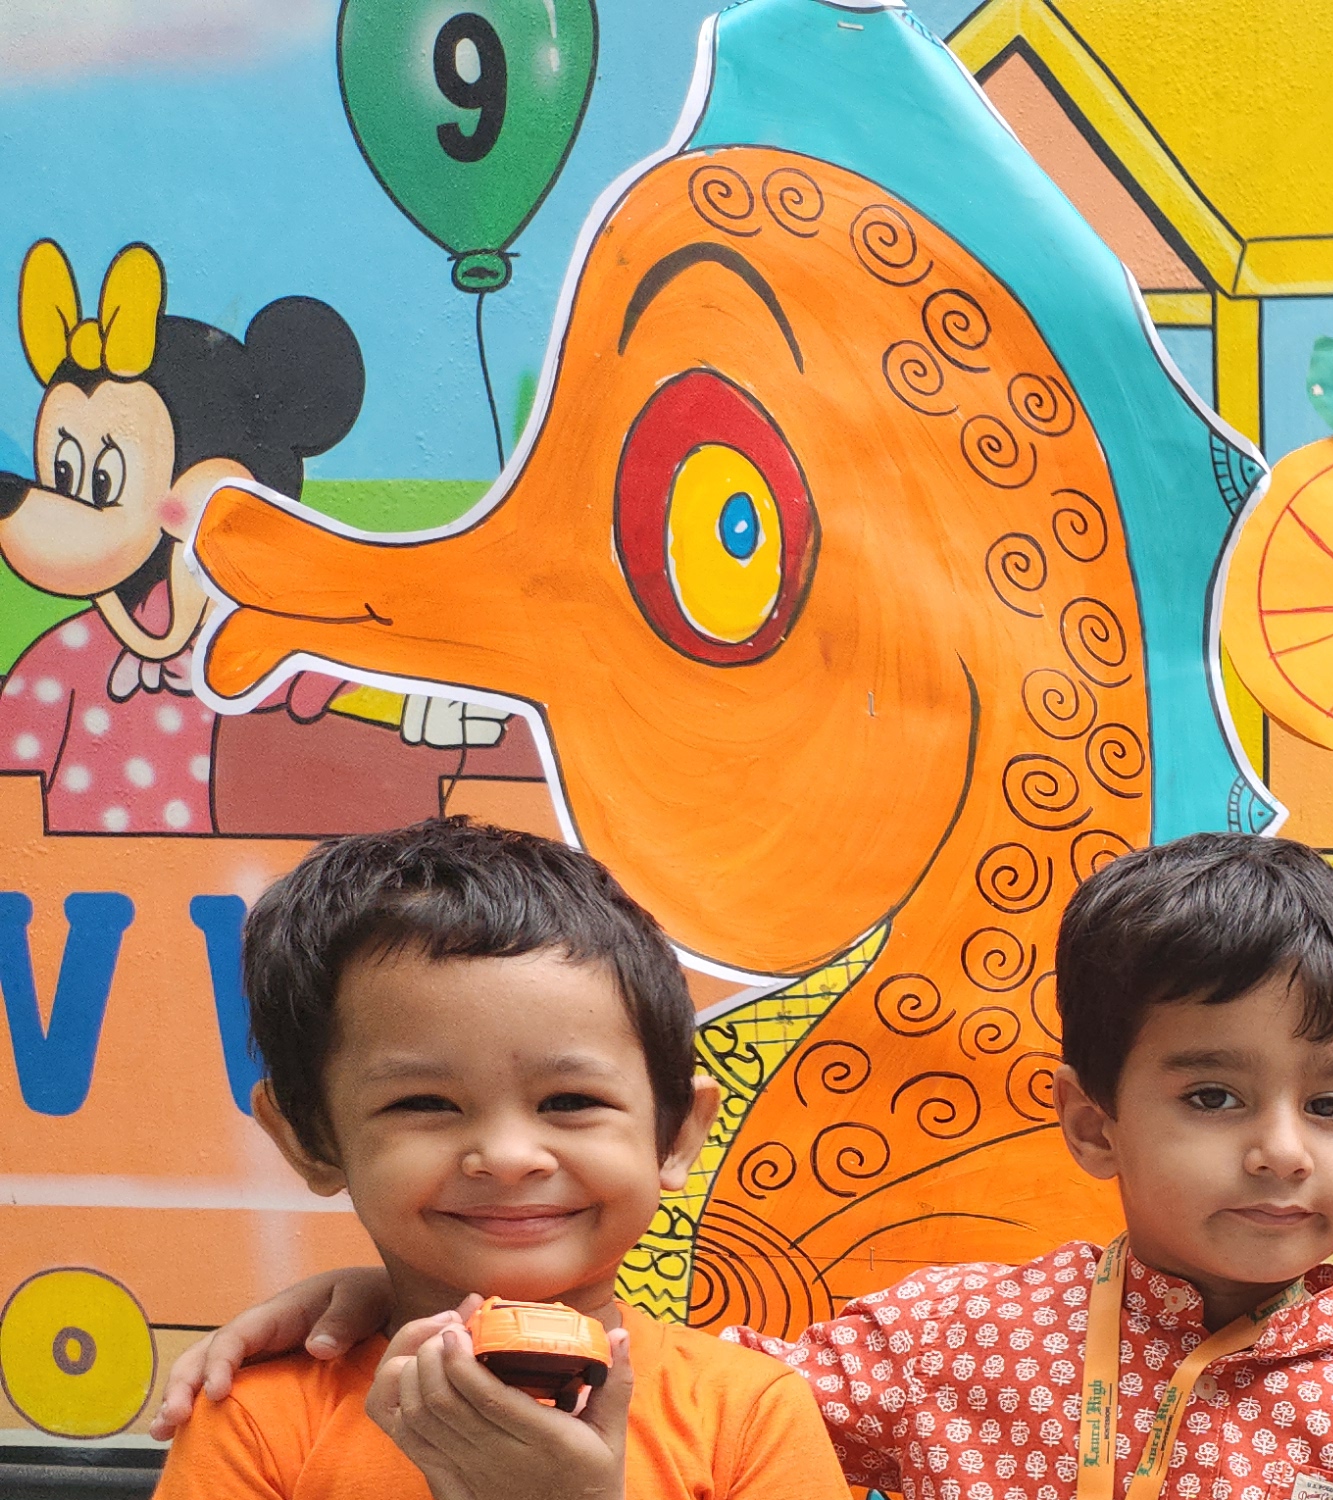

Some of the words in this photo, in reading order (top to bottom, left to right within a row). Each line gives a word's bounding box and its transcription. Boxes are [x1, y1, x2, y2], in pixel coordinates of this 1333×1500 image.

[433, 12, 507, 162] 9
[1086, 1380, 1106, 1415] High
[1136, 1427, 1163, 1477] Laurel
[1156, 1387, 1177, 1424] High
[1083, 1419, 1101, 1467] Laurel
